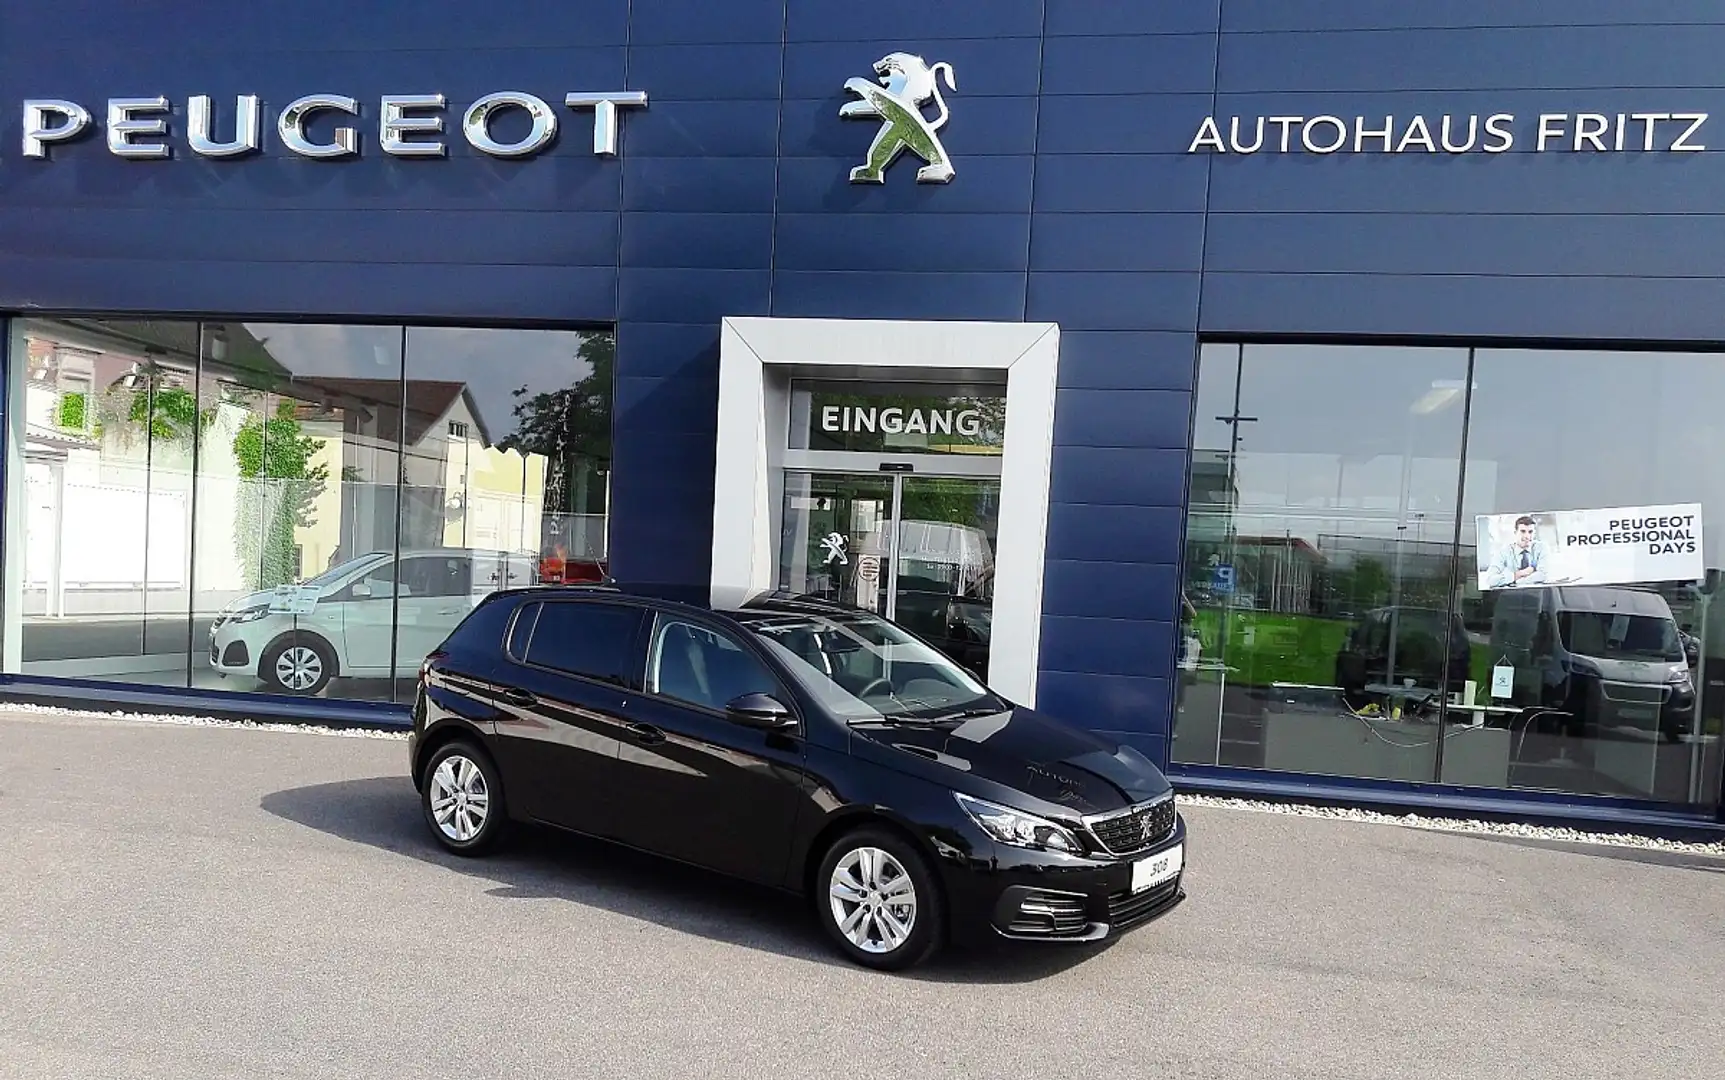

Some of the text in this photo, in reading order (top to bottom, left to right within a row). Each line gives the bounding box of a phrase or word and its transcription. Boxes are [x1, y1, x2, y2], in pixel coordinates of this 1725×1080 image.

[22, 91, 649, 157] PEUGEOT
[1188, 113, 1709, 154] AUTOHAUS FRITZ
[822, 405, 980, 436] EINGANG
[1609, 515, 1694, 531] PEUGEOT
[1566, 529, 1695, 546] PROFESSIONAL
[1649, 541, 1696, 555] DAYS
[1150, 857, 1169, 877] 308
